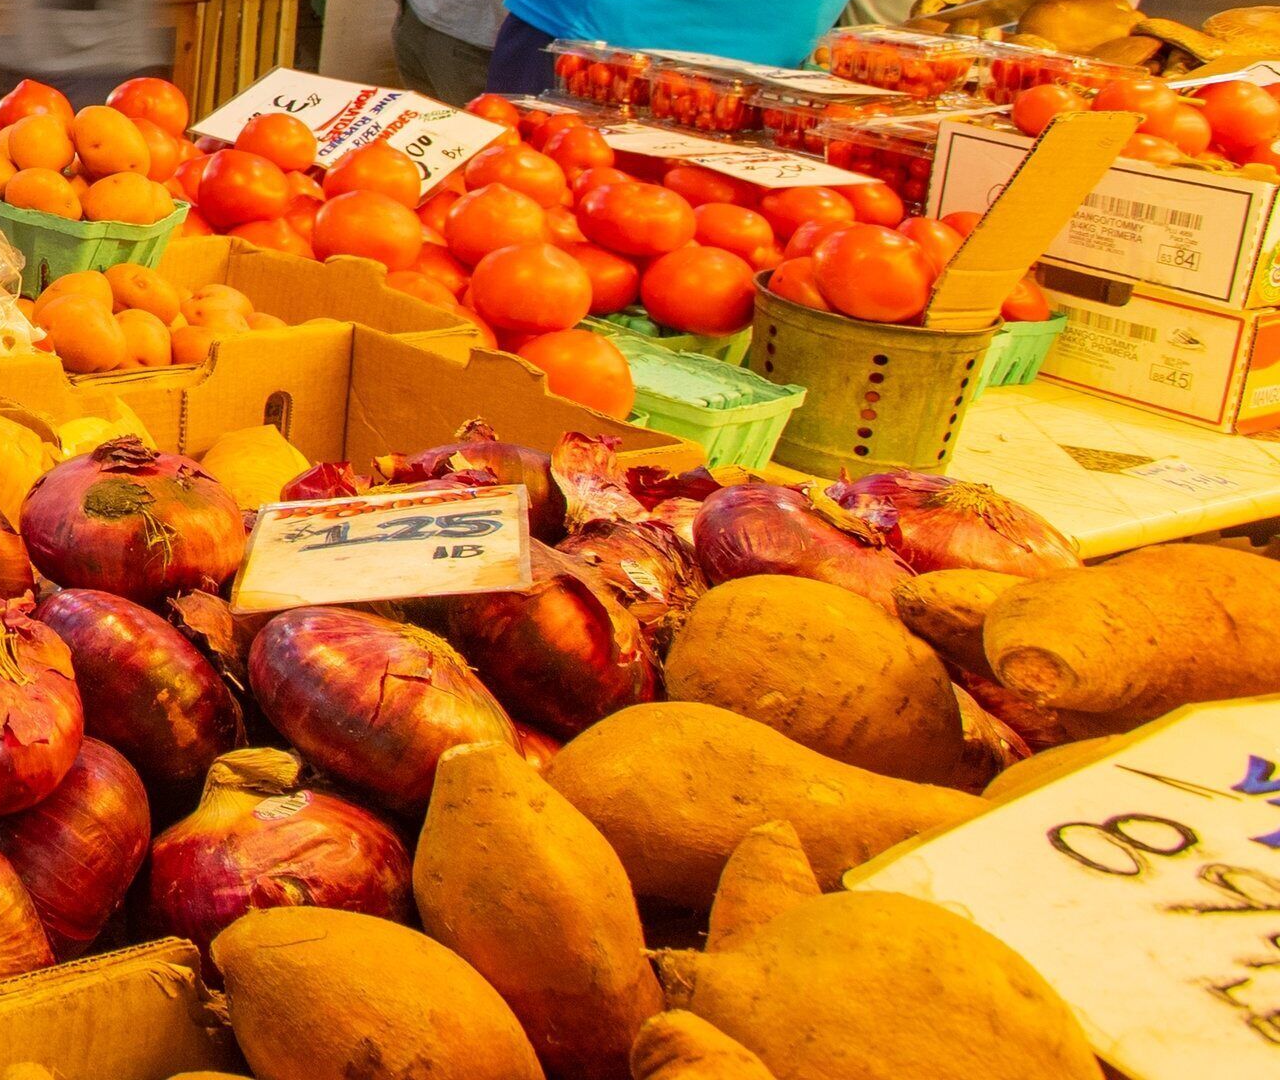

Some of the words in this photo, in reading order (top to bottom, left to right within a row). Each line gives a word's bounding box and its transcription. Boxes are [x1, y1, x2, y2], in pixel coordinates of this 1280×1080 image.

[370, 91, 403, 115] VINE
[317, 115, 371, 157] RIPENED
[1100, 226, 1143, 243] PRIMERA
[1173, 248, 1196, 267] 84
[1091, 342, 1139, 362] PRIMERA
[1165, 371, 1191, 390] 45
